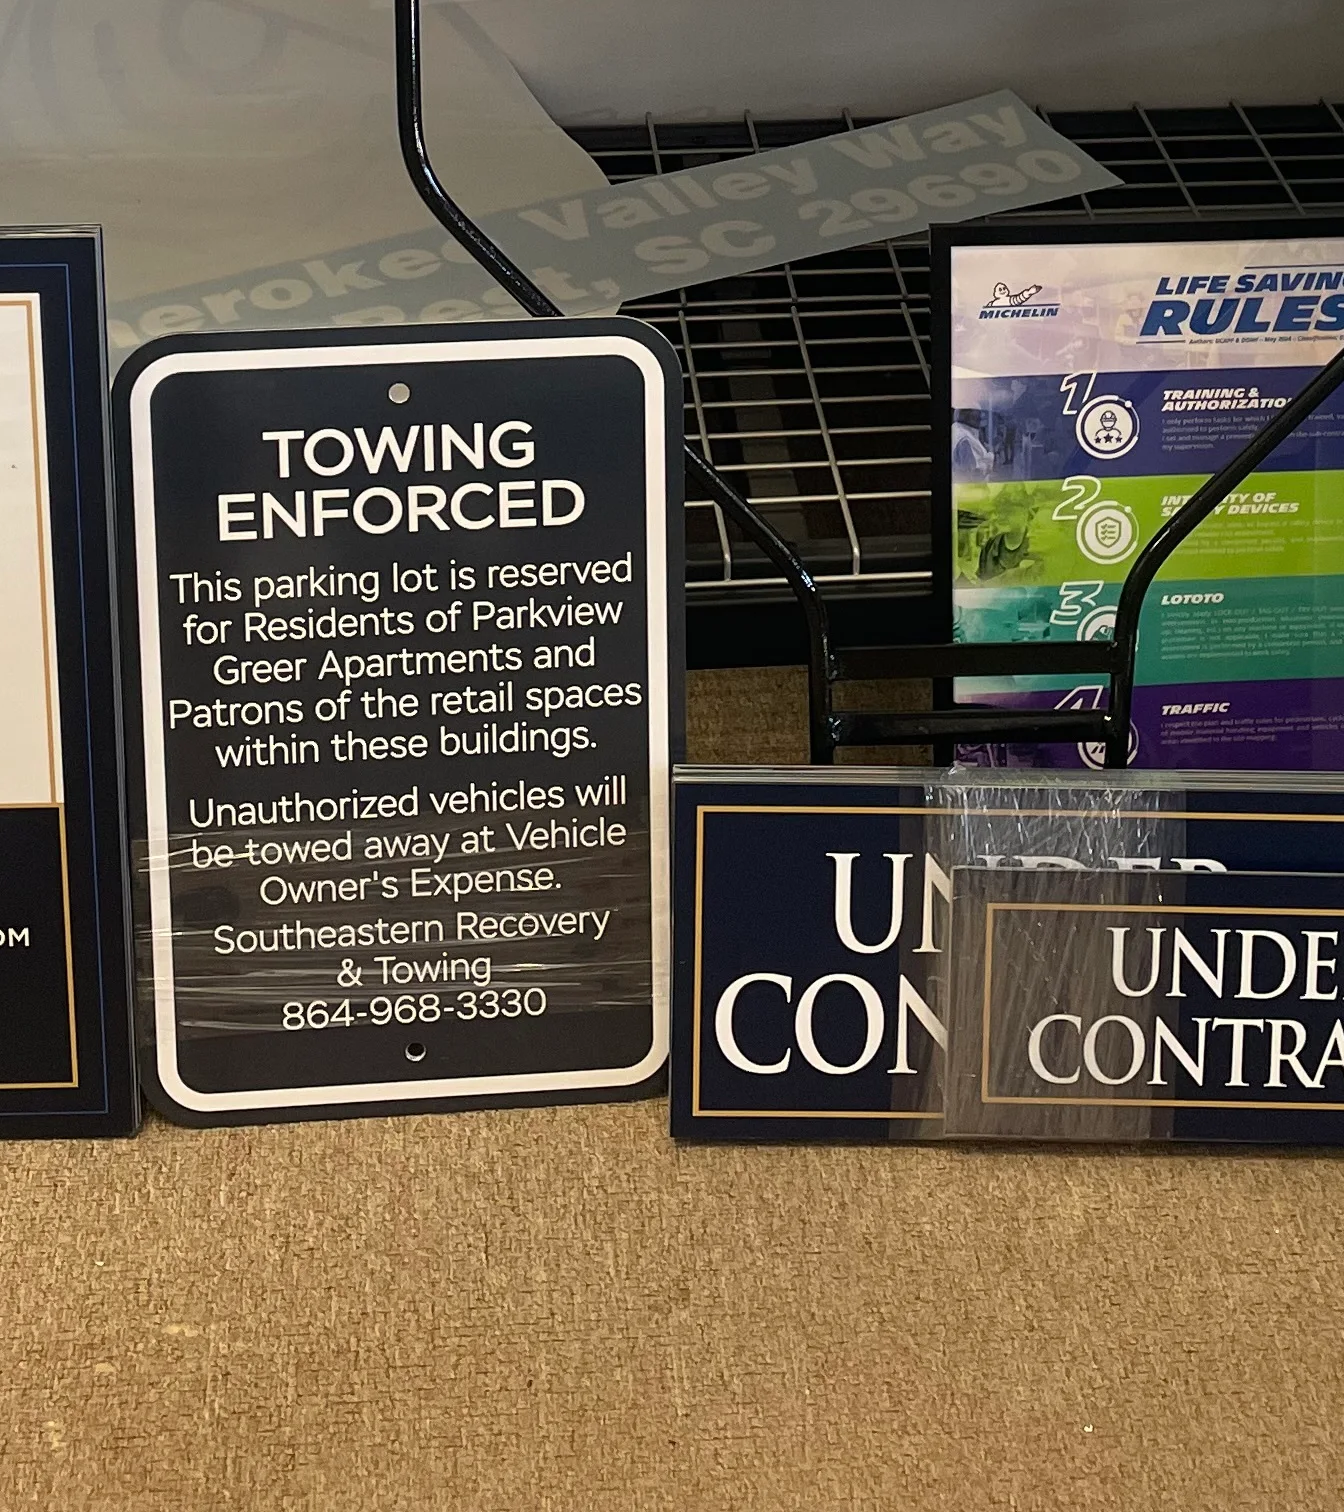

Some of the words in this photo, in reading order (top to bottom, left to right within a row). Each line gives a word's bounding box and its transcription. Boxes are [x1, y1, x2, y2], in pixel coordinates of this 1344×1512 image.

[518, 157, 819, 241] Valley
[828, 105, 1028, 172] Way
[635, 219, 777, 275] SC
[799, 150, 1084, 238] 29690
[1156, 275, 1230, 295] LIFE
[979, 308, 1059, 319] MICHELIN
[1162, 398, 1292, 411] AUTHORIZATIO
[1164, 388, 1245, 400] TRAINING
[1248, 388, 1258, 397] &
[263, 421, 534, 477] TOWING
[219, 480, 584, 541] ENFORCED
[1051, 475, 1101, 521] 2
[1228, 503, 1299, 514] DEVICES
[1253, 493, 1276, 502] OF
[170, 571, 241, 603] This
[255, 565, 379, 607] parking
[393, 563, 438, 592] lot
[451, 560, 475, 590] is
[489, 552, 631, 588] reserved
[1050, 580, 1104, 625] 3
[1161, 593, 1224, 605] LOTOTO
[183, 614, 234, 644] for
[245, 607, 414, 641] Residents
[426, 601, 462, 632] of
[473, 596, 623, 630] Parkview
[214, 655, 307, 684] Greer
[318, 644, 522, 686] Apartments
[534, 636, 594, 668] and
[170, 699, 303, 729] Patrons
[315, 690, 352, 721] of
[361, 688, 418, 718] the
[432, 681, 512, 715] retail
[526, 683, 641, 717] spaces
[1162, 703, 1230, 715] TRAFFIC
[215, 734, 319, 767] within
[331, 731, 427, 761] these
[440, 720, 597, 764] buildings.
[190, 786, 418, 827] Unauthorized
[430, 781, 564, 814] vehicles
[575, 775, 625, 806] will
[192, 837, 237, 868] be
[246, 831, 352, 864] towed
[364, 831, 450, 868] away
[461, 826, 495, 853] at
[506, 817, 626, 850] Vehicle
[260, 870, 398, 906] Owner's
[412, 864, 562, 902] Expense.
[215, 919, 447, 956] Southeastern
[457, 909, 610, 946] Recovery
[337, 959, 363, 987] &
[374, 952, 492, 988] Towing
[283, 988, 546, 1030] 864-968-3330
